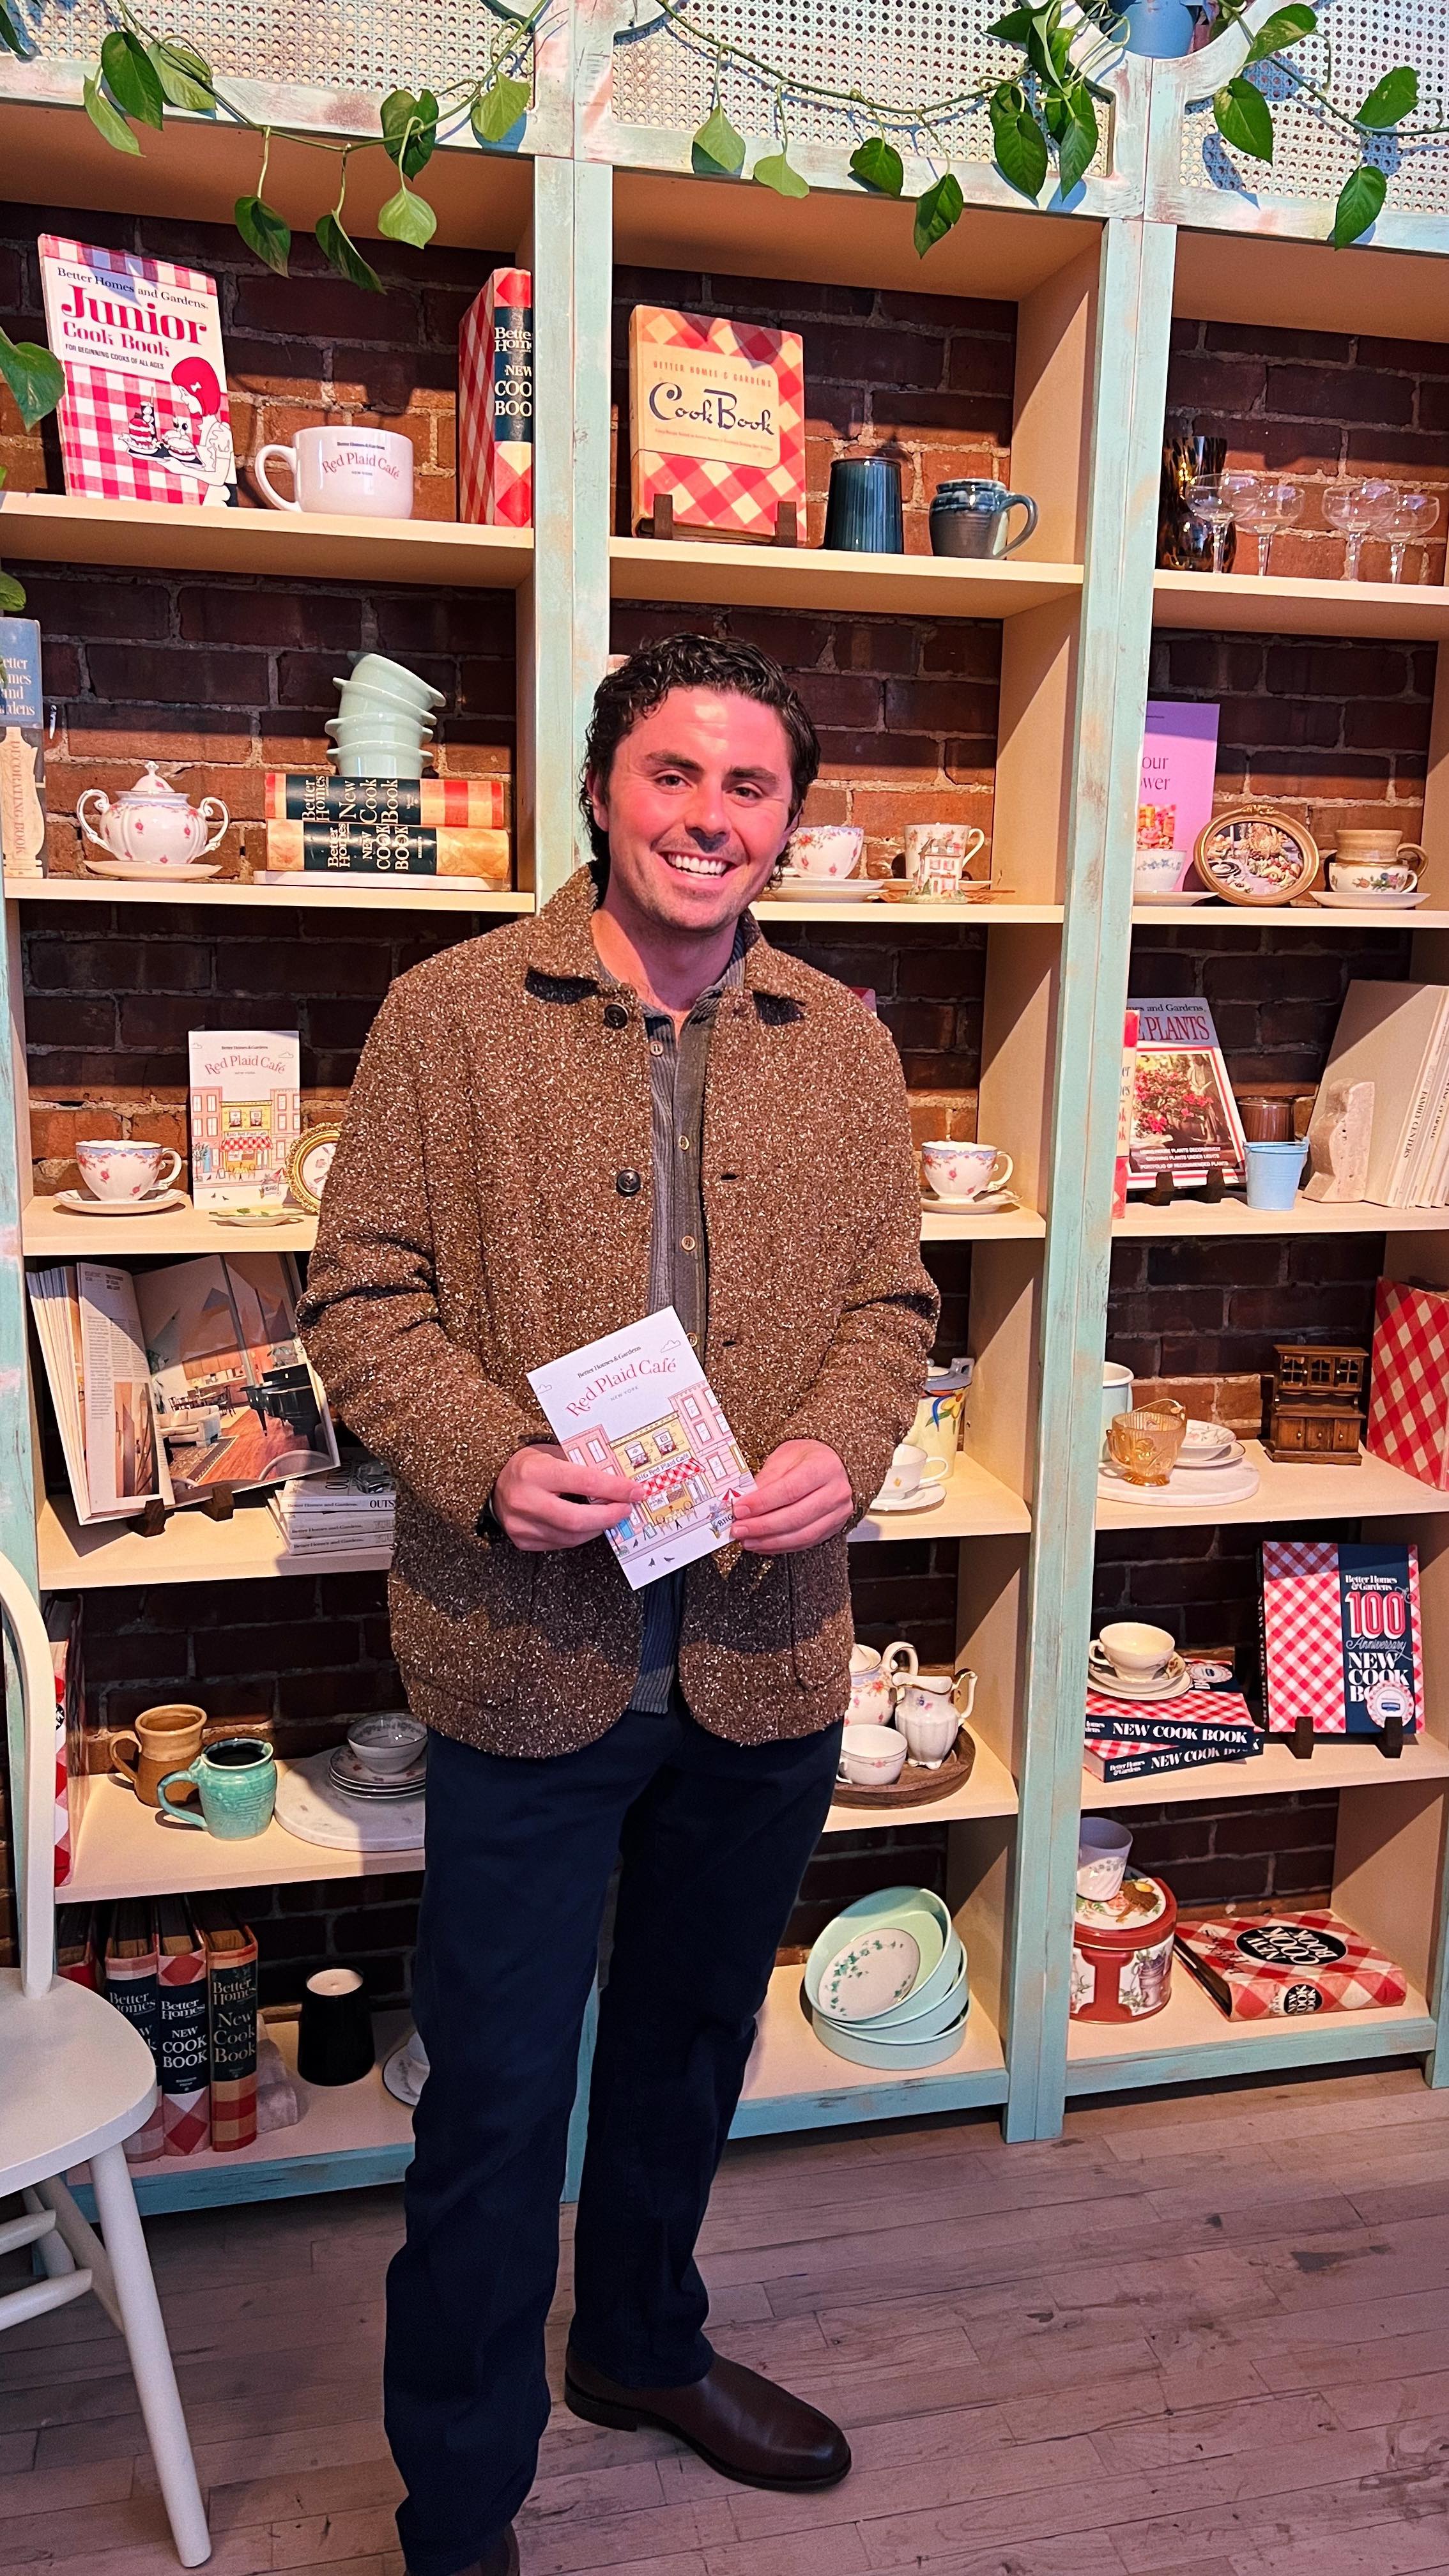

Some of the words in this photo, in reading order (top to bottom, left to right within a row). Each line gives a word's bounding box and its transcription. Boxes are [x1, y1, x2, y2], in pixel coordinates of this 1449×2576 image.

[57, 267, 92, 284] Better
[95, 276, 134, 293] Homes
[138, 286, 158, 298] and
[61, 284, 207, 345] Junior
[64, 321, 114, 346] Cook
[121, 333, 170, 357] Book
[494, 327, 532, 340] Bette
[65, 344, 77, 352] FOR
[78, 345, 109, 358] BEGINNING
[111, 353, 130, 362] COOKS
[139, 358, 149, 367] ALL
[150, 361, 164, 369] AGES
[494, 340, 532, 352] Hom
[505, 365, 532, 377] NEW
[654, 361, 684, 372] BETTER
[690, 366, 717, 378] HOMES
[733, 374, 771, 387] GARDENS
[494, 380, 532, 397] COO
[494, 400, 532, 417] BOO
[322, 454, 344, 473] Red
[346, 452, 376, 466] Plaid
[378, 457, 400, 480] Café
[3, 657, 28, 670] etter
[8, 674, 32, 685] mes
[0, 702, 35, 715] dens
[1142, 756, 1169, 769] our
[10, 741, 24, 818] DECORATING
[1140, 778, 1170, 790] wer
[302, 779, 316, 821] Better
[316, 775, 330, 822] Homes
[339, 780, 356, 820] New
[360, 778, 378, 824] Cook
[381, 779, 399, 824] Book
[14, 823, 26, 854] BOOK
[328, 827, 339, 868] Better
[339, 823, 350, 868] Homes
[362, 831, 373, 861] NEW
[376, 824, 392, 870] COOK
[395, 826, 410, 870] BOOK
[1144, 1016, 1210, 1041] PLANTS
[204, 1057, 228, 1075] Red
[230, 1055, 259, 1067] Plaid
[261, 1057, 286, 1074] Café
[1414, 1091, 1429, 1118] FAMILY
[1404, 1121, 1419, 1158] CENTERS
[577, 1368, 594, 1378] Better
[594, 1360, 614, 1371] Homes
[618, 1346, 641, 1360] Gardens
[565, 1386, 598, 1416] Red
[594, 1363, 637, 1393] Plaid
[639, 1358, 676, 1375] Café
[624, 1386, 638, 1395] YORK
[649, 1467, 660, 1475] Red
[661, 1460, 676, 1470] Plaid
[676, 1453, 689, 1462] Café
[369, 1499, 395, 1508] OUTS
[717, 1514, 733, 1527] BHG
[1345, 1575, 1370, 1584] Better
[1370, 1575, 1398, 1584] Homes
[1345, 1591, 1406, 1639] 100
[1346, 1637, 1407, 1655] Anniversary
[1348, 1652, 1398, 1669] NEW
[1348, 1669, 1409, 1686] COOK
[1112, 1722, 1150, 1736] NEW
[1153, 1726, 1198, 1740] COOK
[1202, 1729, 1247, 1744] BOOK
[1151, 1753, 1183, 1769] NEW
[1184, 1747, 1220, 1763] COOK
[1243, 1936, 1286, 1960] NEW
[1257, 1927, 1319, 1965] COOK
[1289, 1929, 1338, 1958] BOOK
[213, 1979, 252, 1994] Better
[214, 1987, 256, 2005] Homes
[110, 1992, 150, 2005] Better
[162, 1999, 199, 2011] Better
[162, 2004, 206, 2020] Homes
[218, 2011, 253, 2028] New
[162, 2034, 207, 2053] COOK
[172, 2027, 198, 2039] NEW
[213, 2024, 256, 2045] Cook
[163, 2050, 208, 2068] BOOK
[215, 2042, 256, 2063] Book
